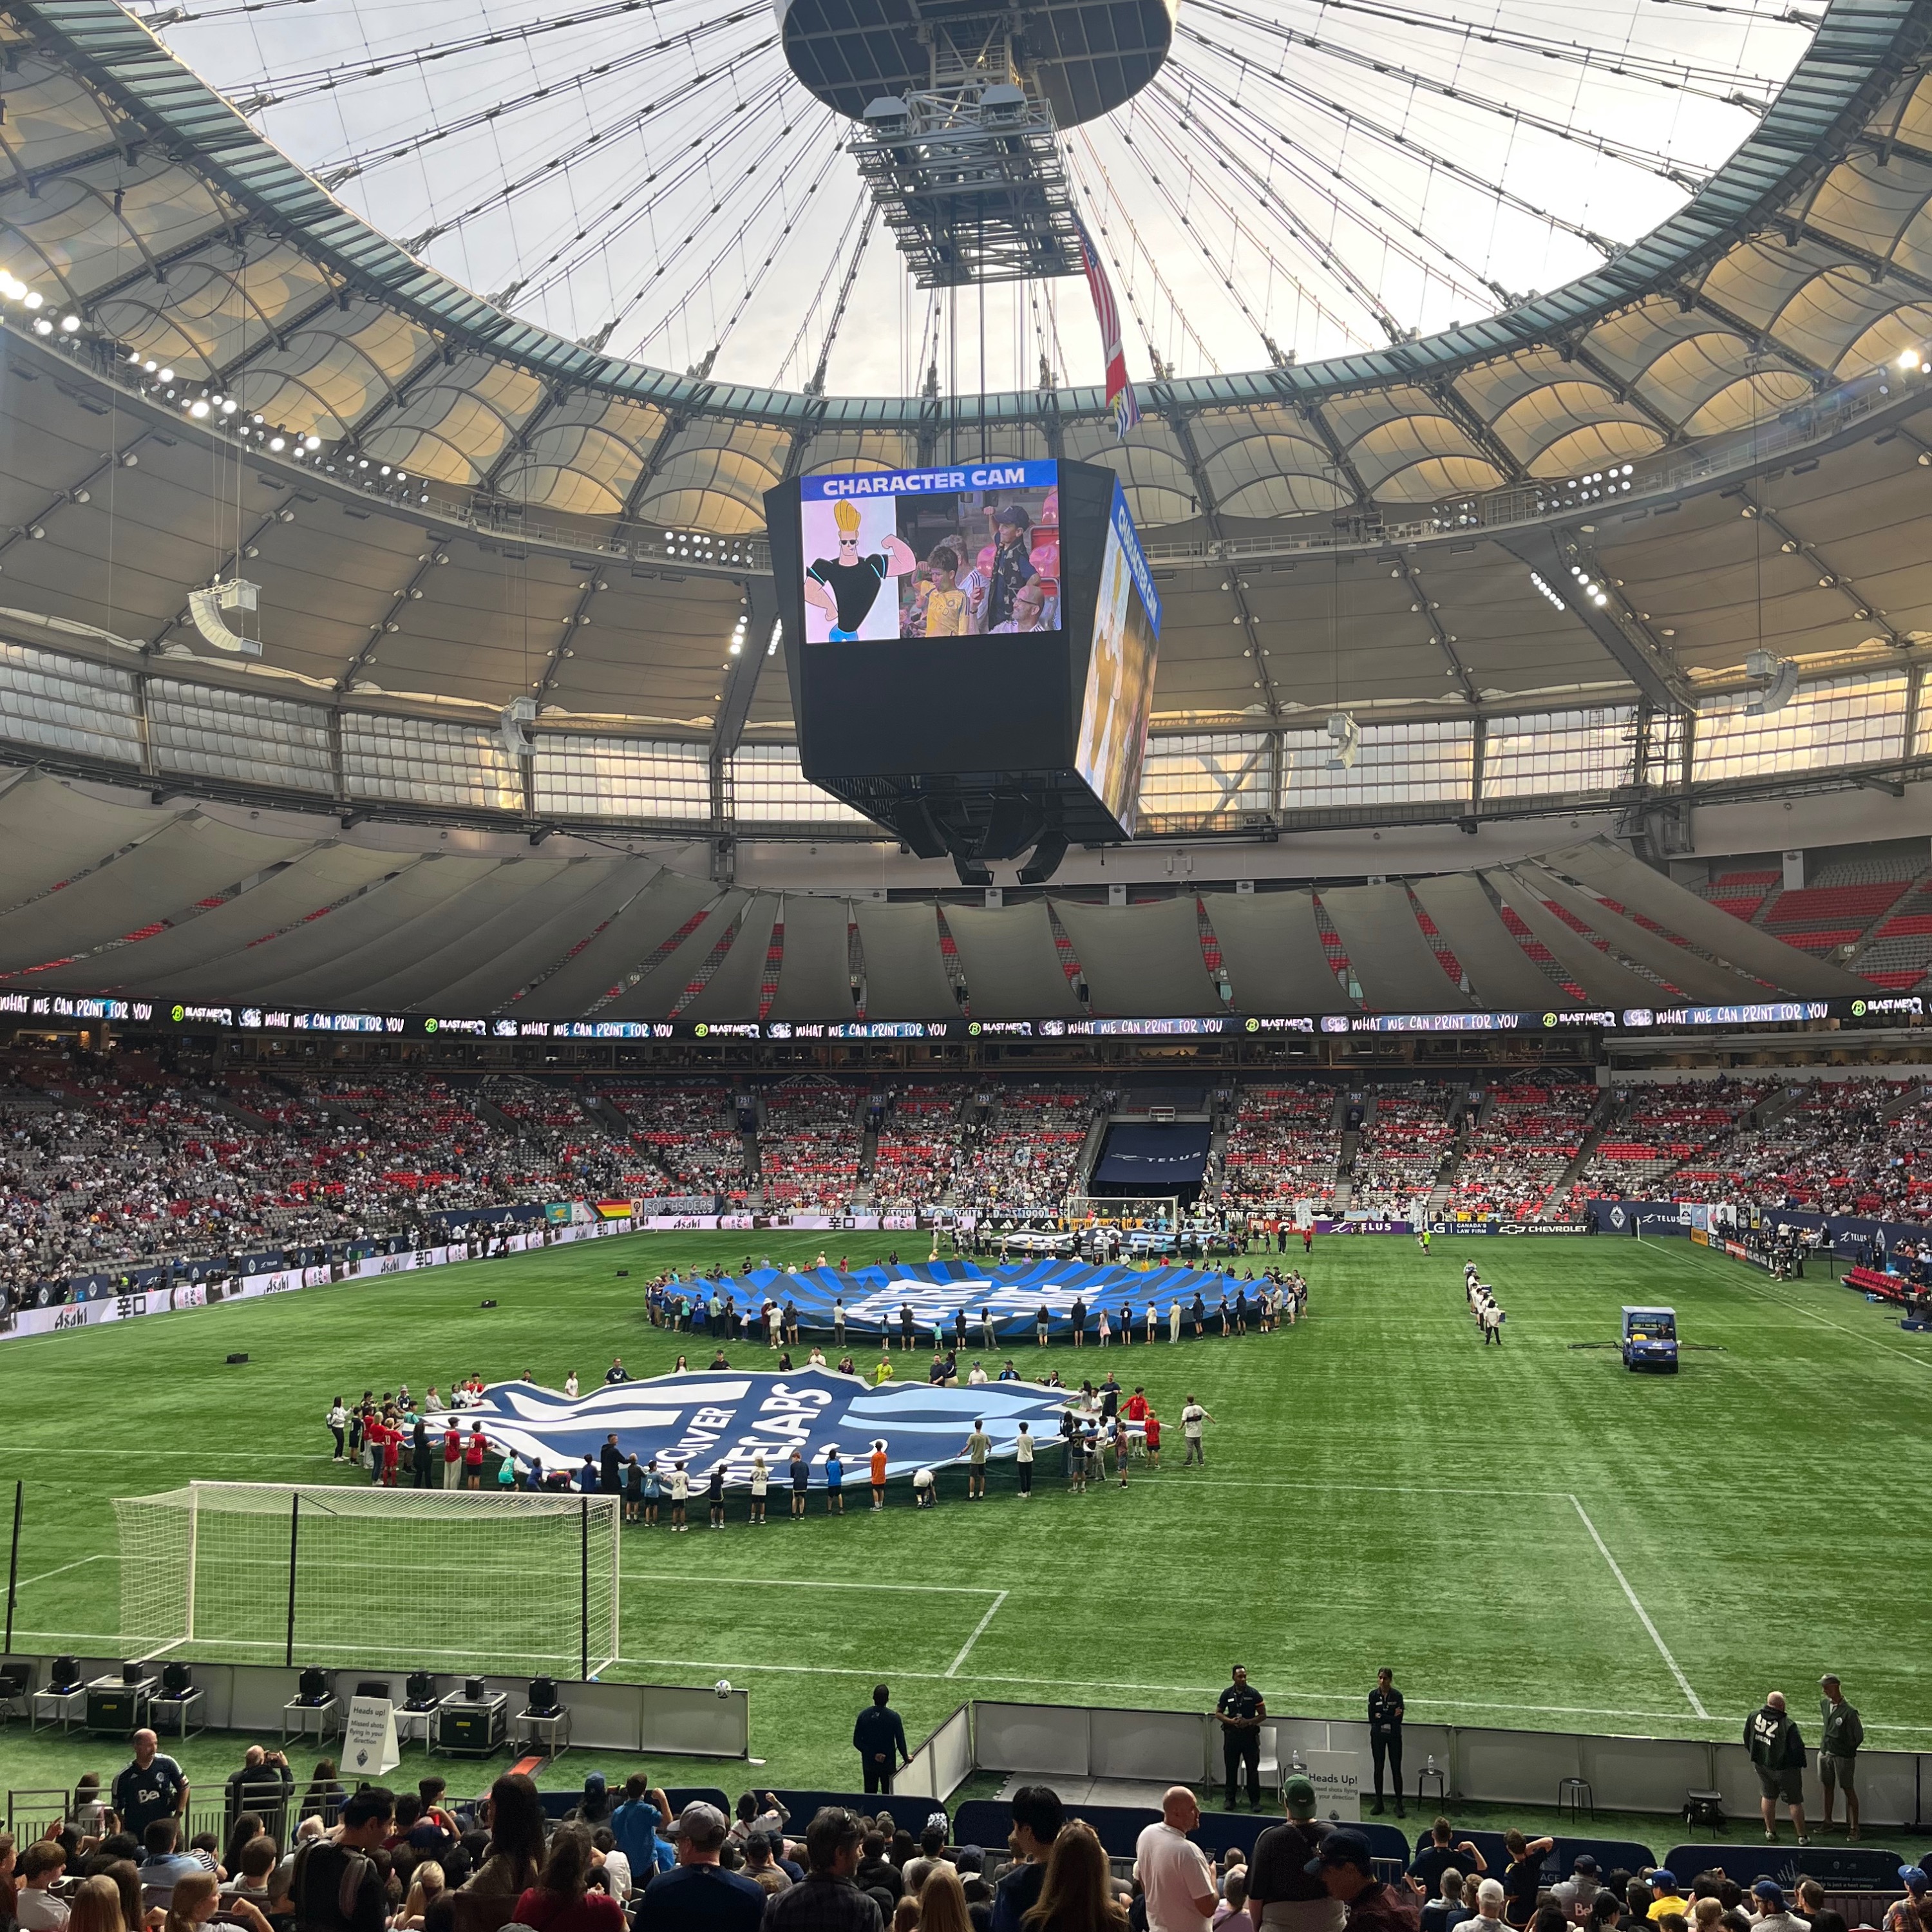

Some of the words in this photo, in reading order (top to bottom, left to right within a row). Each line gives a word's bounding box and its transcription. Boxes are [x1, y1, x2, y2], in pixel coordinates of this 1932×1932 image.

[823, 472, 965, 497] CHARACTER
[971, 468, 1025, 486] CAM
[0, 993, 30, 1013] WHAT
[33, 997, 50, 1014] WE
[55, 997, 73, 1015] CAN
[77, 998, 106, 1018] PRINT
[109, 1001, 128, 1019] FOR
[133, 1002, 152, 1020] YOU
[1656, 1009, 1689, 1024] WHAT
[1694, 1009, 1712, 1023] WE
[1717, 1007, 1738, 1021] CAN
[1742, 1005, 1776, 1022] PRINT
[1781, 1003, 1802, 1019] FOR
[1807, 1003, 1829, 1018] YOU
[265, 1010, 291, 1028] WHAT
[294, 1013, 309, 1028] WE
[313, 1013, 331, 1028] CAN
[335, 1014, 361, 1030] PRINT
[365, 1015, 382, 1031] FOR
[386, 1016, 404, 1032] YOU
[1068, 1019, 1096, 1034] WHAT
[1101, 1021, 1117, 1034] WE
[1121, 1020, 1140, 1034] CAN
[1144, 1020, 1173, 1034] PRINT
[1179, 1019, 1197, 1034] FOR
[1202, 1019, 1222, 1034] YOU
[1352, 1016, 1383, 1030] WHAT
[1387, 1017, 1405, 1030] WE
[1410, 1016, 1430, 1029] CAN
[1434, 1015, 1466, 1030] PRINT
[1471, 1014, 1492, 1028] FOR
[1497, 1014, 1519, 1028] YOU
[521, 1021, 550, 1036] WHAT
[553, 1022, 569, 1036] WE
[573, 1022, 592, 1036] CAN
[596, 1022, 625, 1037] PRINT
[630, 1023, 649, 1037] FOR
[653, 1023, 673, 1037] YOU
[795, 1023, 824, 1037] WHAT
[828, 1024, 844, 1037] WE
[849, 1023, 867, 1037] CAN
[871, 1023, 900, 1037] PRINT
[904, 1023, 923, 1036] FOR
[927, 1023, 947, 1036] YOU
[1146, 1151, 1201, 1162] TELUS
[674, 1218, 701, 1229] Asahi
[266, 1275, 289, 1293] Asahi
[55, 1307, 88, 1329] Asahi
[754, 1471, 766, 1481] 25
[375, 1709, 385, 1718] up!
[1754, 1714, 1778, 1738] 92
[1309, 1773, 1338, 1783] Heads
[1341, 1775, 1358, 1786] Up!
[1540, 1873, 1561, 1882] ACE
[1575, 1903, 1593, 1916] Bel
